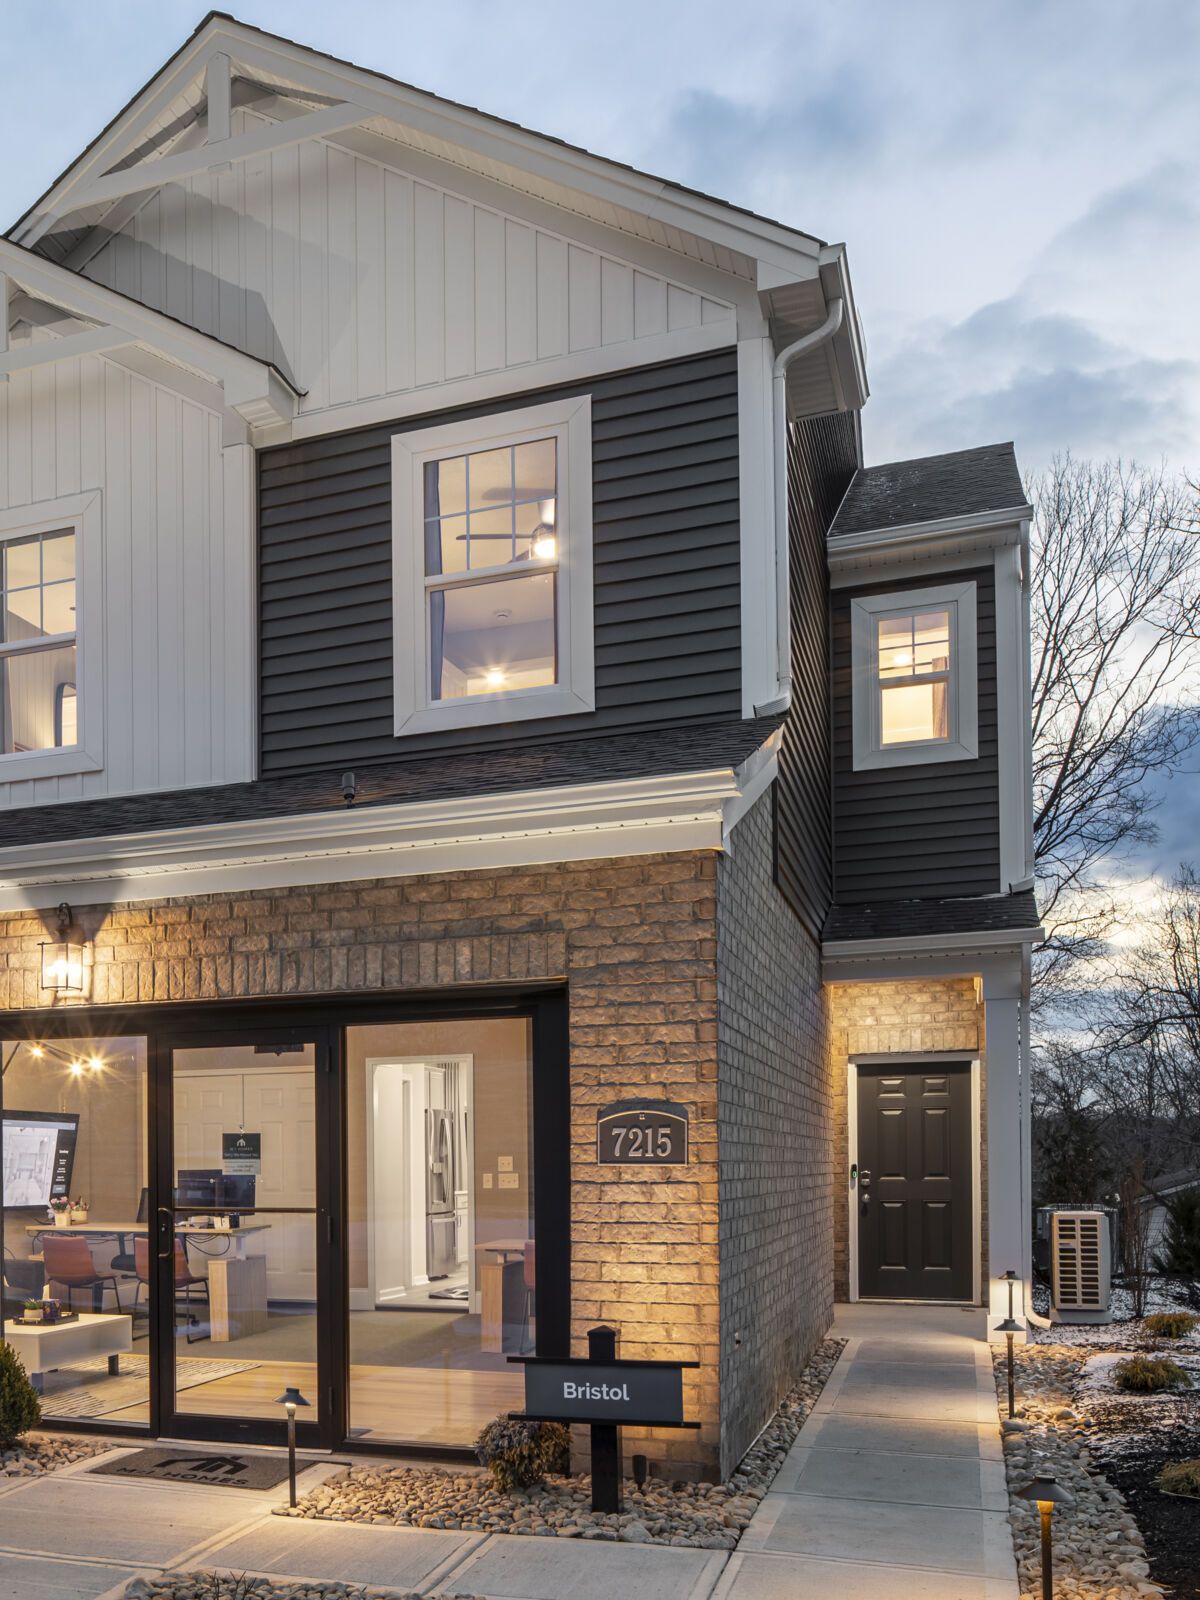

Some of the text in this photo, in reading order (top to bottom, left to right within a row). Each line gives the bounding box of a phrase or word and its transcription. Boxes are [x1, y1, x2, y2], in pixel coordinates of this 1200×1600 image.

[611, 1127, 672, 1157] 7215
[563, 1382, 630, 1401] Bristol
[161, 1471, 249, 1486] HOMES
